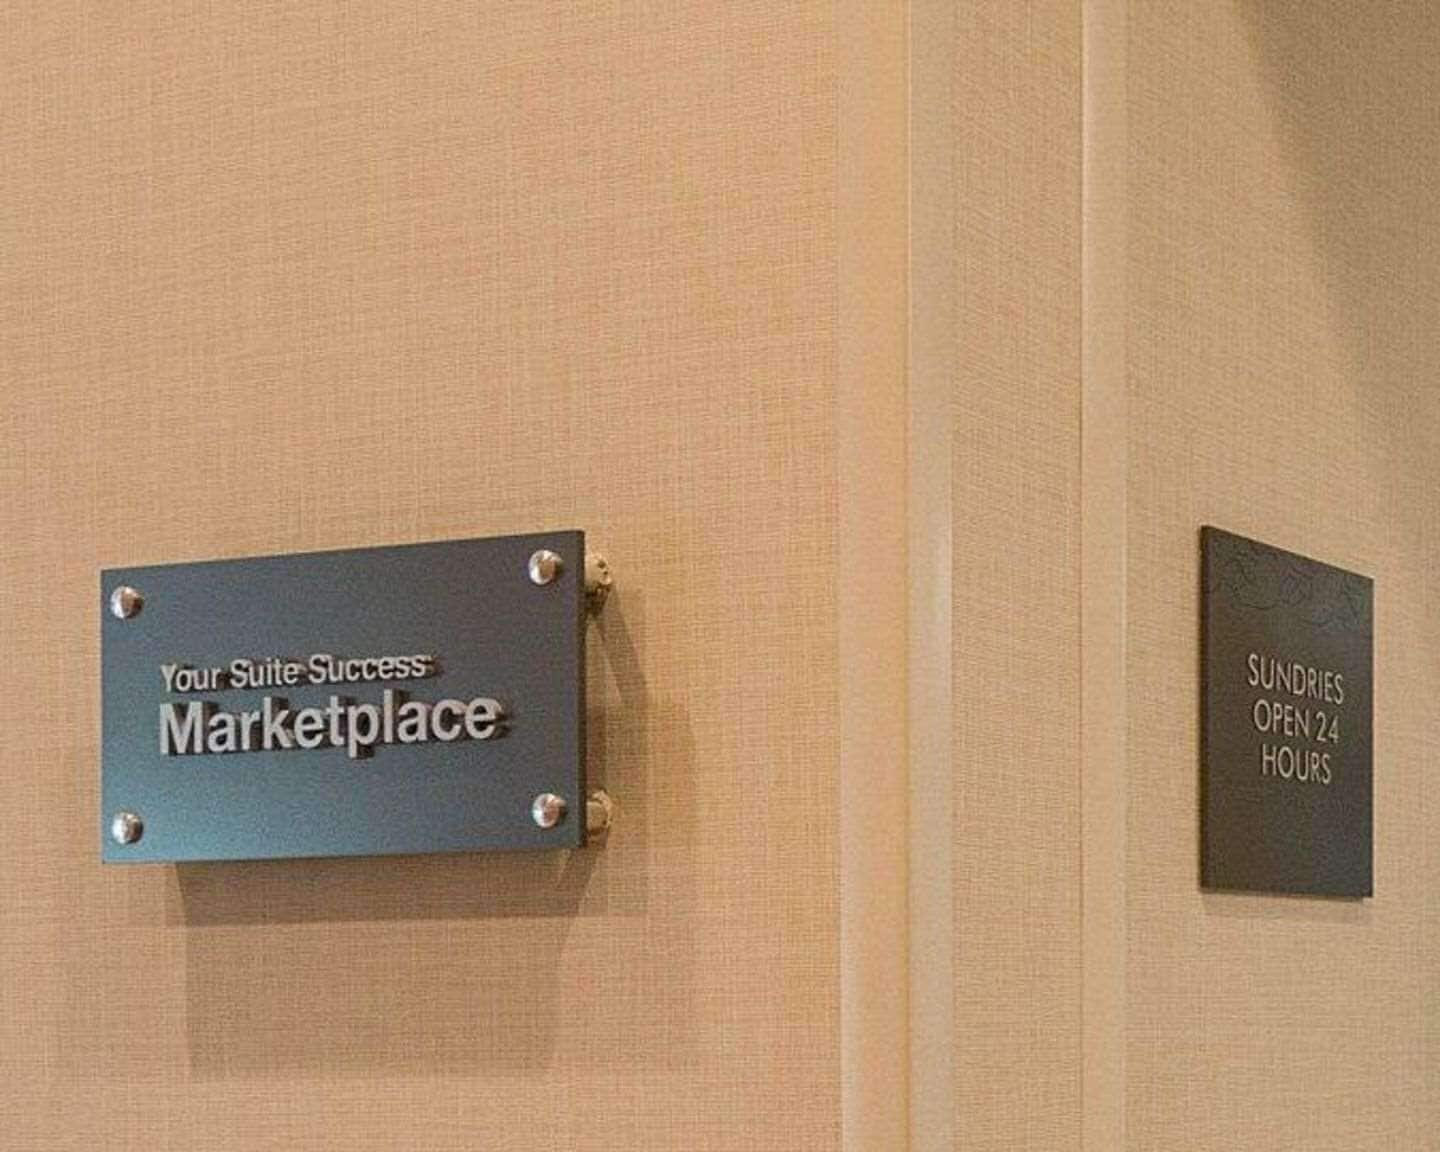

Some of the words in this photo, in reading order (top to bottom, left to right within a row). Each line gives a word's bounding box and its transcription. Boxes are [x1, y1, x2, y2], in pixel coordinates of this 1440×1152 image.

[160, 663, 222, 692] Your
[229, 658, 300, 688] Suite
[307, 653, 433, 684] Success
[1247, 653, 1344, 705] SUNDRIES
[159, 688, 503, 758] Marketplace
[1253, 699, 1309, 738] OPEN
[1315, 710, 1339, 744] 24
[1261, 743, 1332, 785] HOURS
